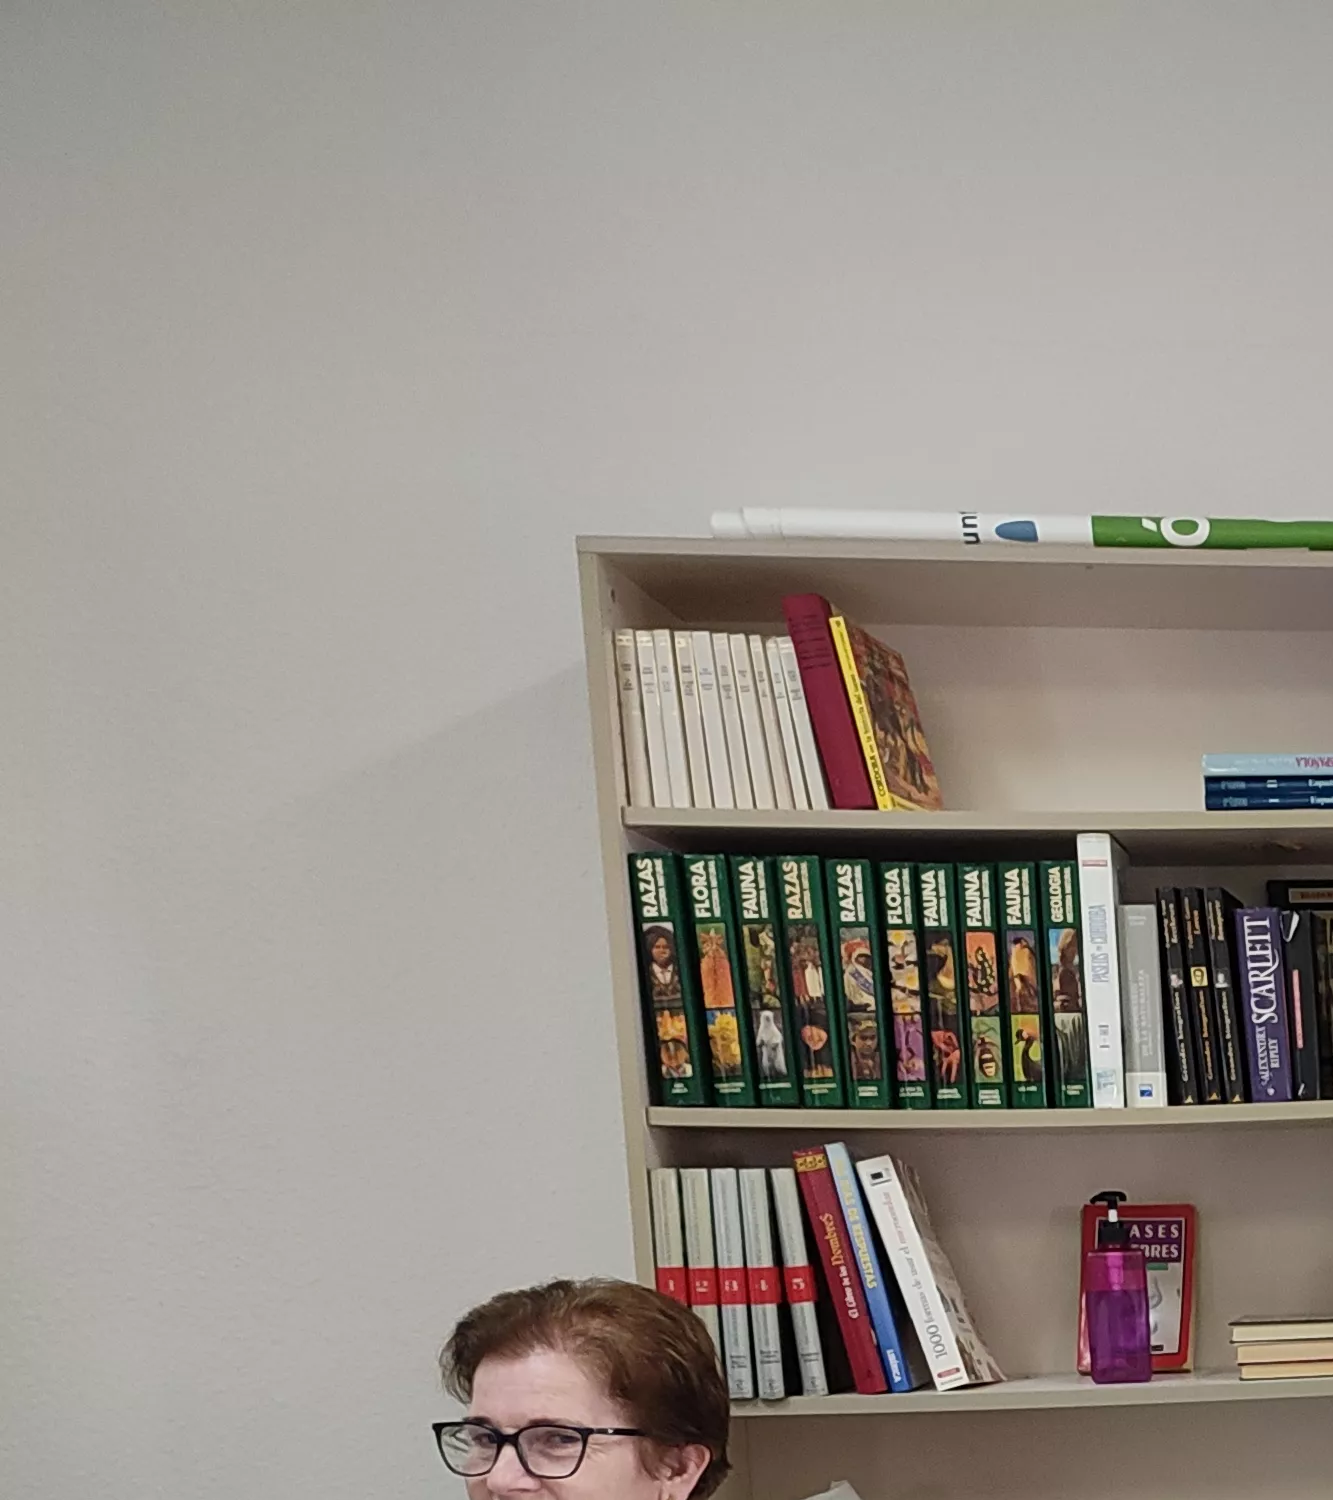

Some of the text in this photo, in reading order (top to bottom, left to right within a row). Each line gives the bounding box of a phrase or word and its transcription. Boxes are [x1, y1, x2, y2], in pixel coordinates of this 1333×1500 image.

[636, 857, 659, 918] RAZAS
[689, 860, 712, 918] FLORA
[738, 861, 760, 919] FAUNA
[782, 861, 803, 919] RAZAS
[836, 864, 856, 922] RAZAS
[884, 867, 904, 924] FLORA
[921, 869, 939, 927] FAUNA
[963, 869, 983, 927] FAUNA
[1004, 867, 1022, 925] FAUNA
[1242, 915, 1280, 1024] SCARLETT
[1129, 1224, 1180, 1239] ASES
[912, 1278, 923, 1290] de
[926, 1324, 949, 1359] 1000
